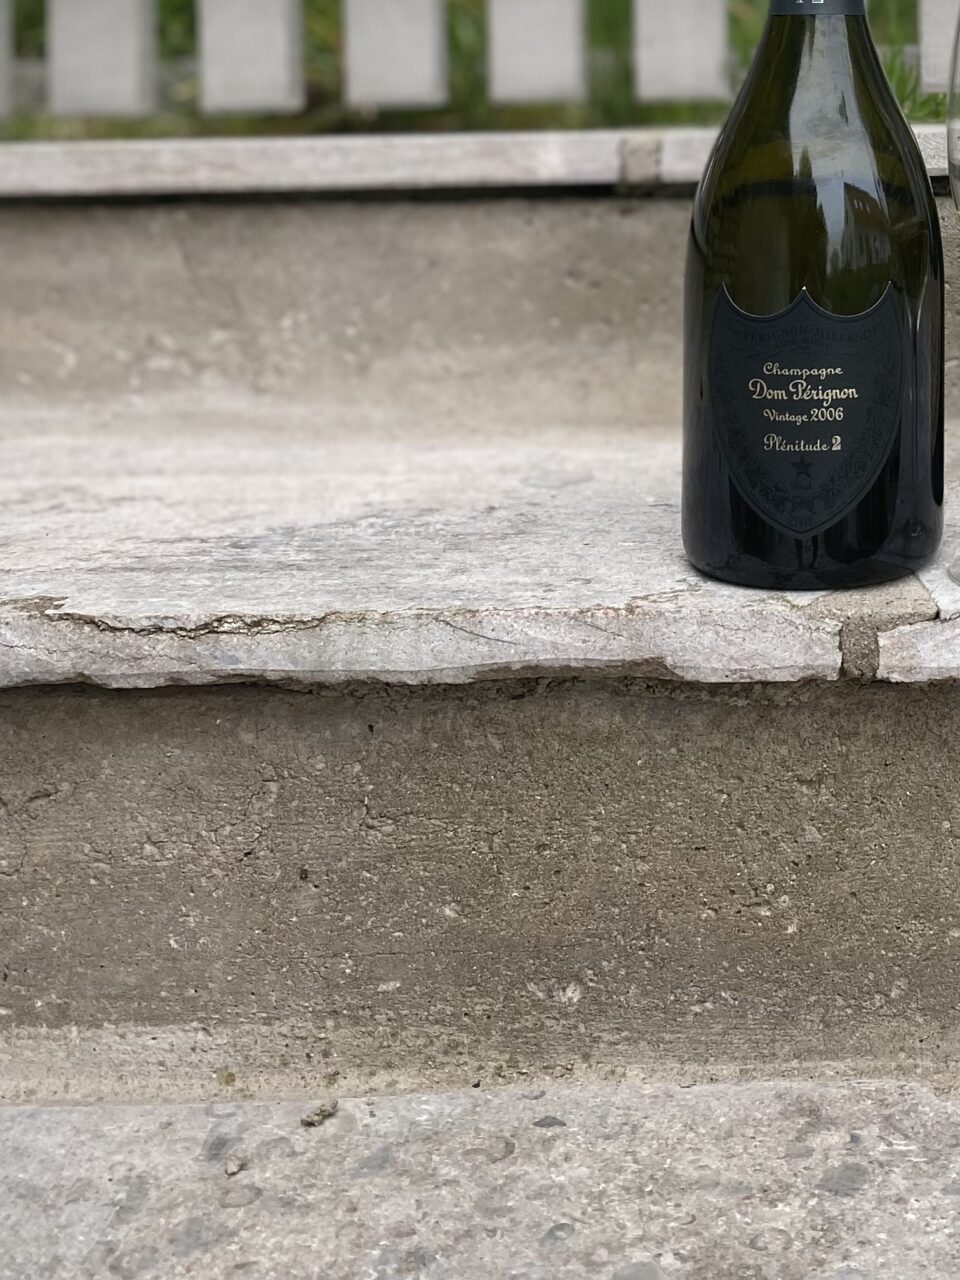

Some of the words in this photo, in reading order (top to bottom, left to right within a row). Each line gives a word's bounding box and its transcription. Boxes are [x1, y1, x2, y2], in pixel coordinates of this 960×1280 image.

[763, 362, 844, 380] Champagne
[748, 378, 788, 400] Dom
[788, 379, 859, 407] Pérignon
[763, 408, 809, 426] Vintage
[810, 407, 844, 421] 2006
[763, 433, 830, 452] Plénitude
[831, 435, 842, 451] 2
